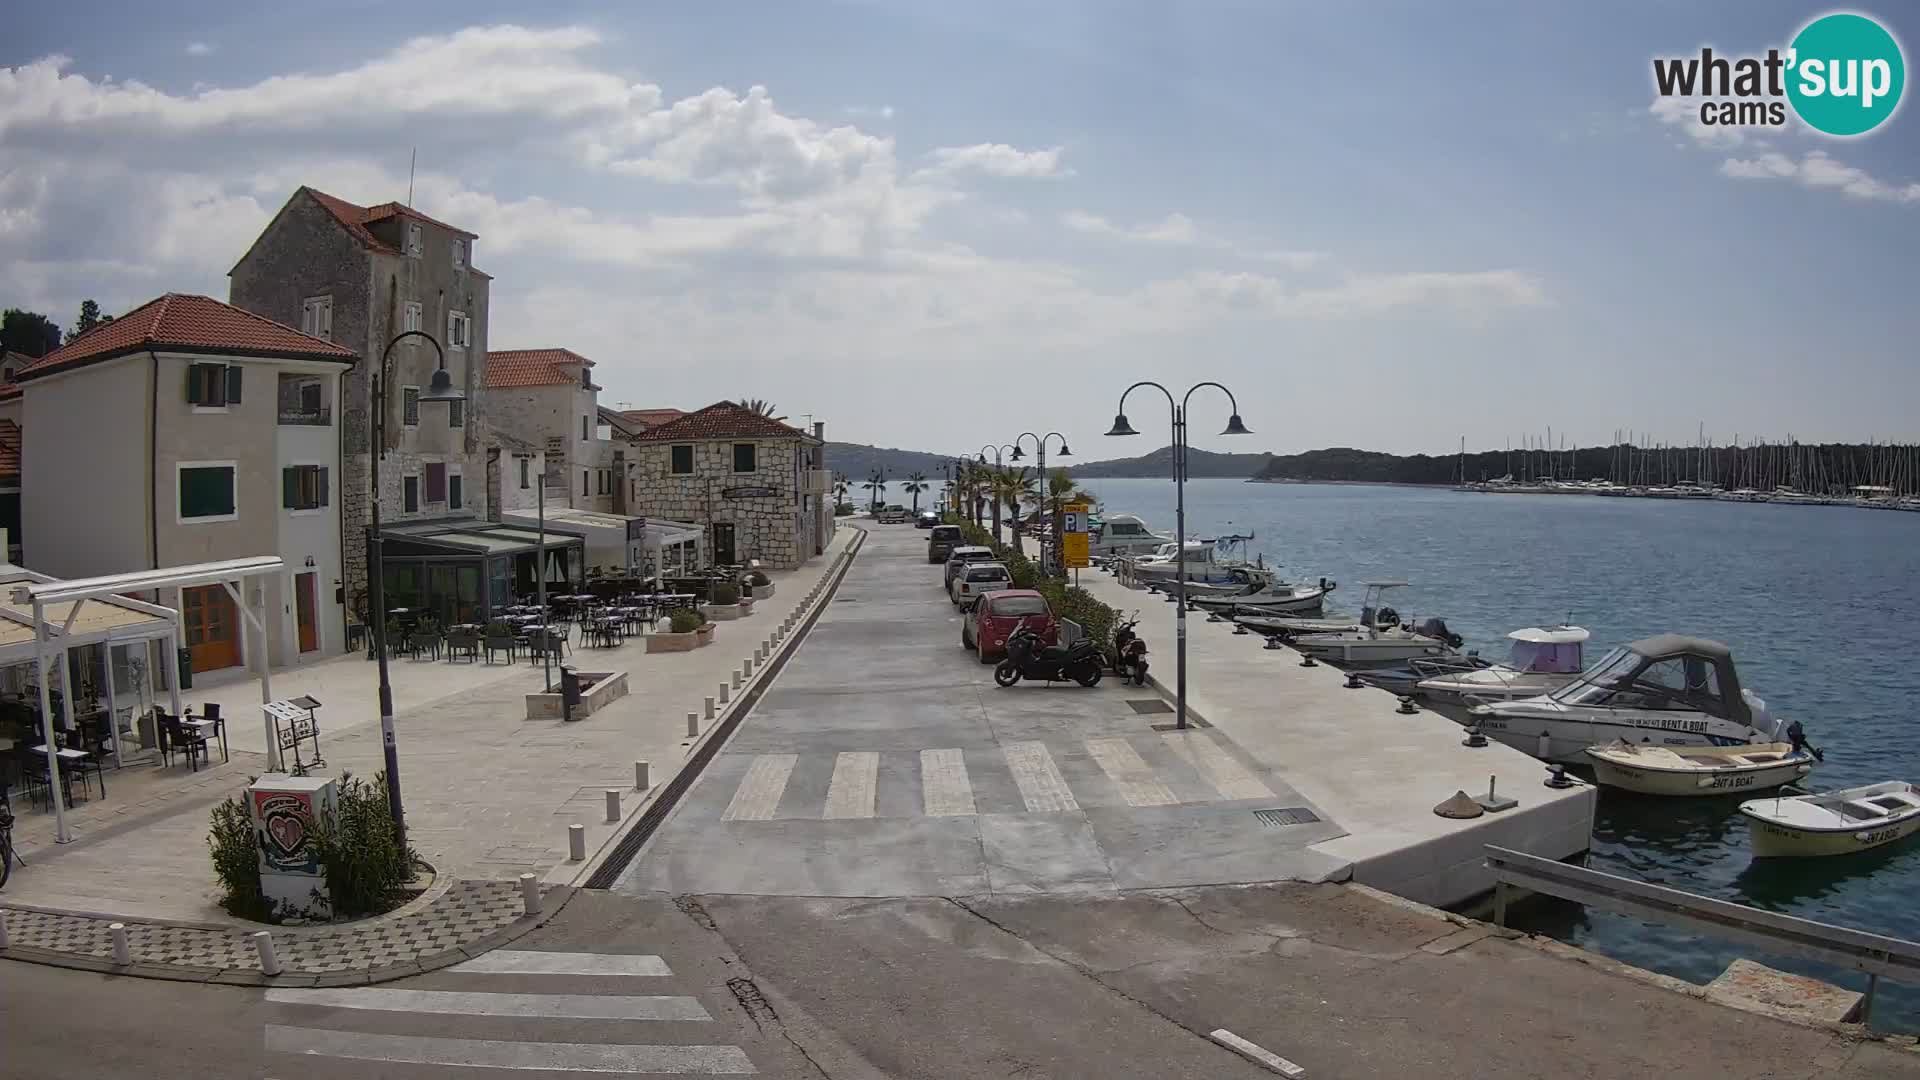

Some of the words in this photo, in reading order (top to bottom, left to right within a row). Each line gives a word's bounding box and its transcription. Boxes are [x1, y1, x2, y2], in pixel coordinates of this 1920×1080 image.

[1661, 719, 1682, 730] RENT
[1683, 720, 1688, 730] A
[1689, 721, 1708, 732] BOAT
[1712, 777, 1728, 788] ENT
[1735, 776, 1754, 787] BOAT
